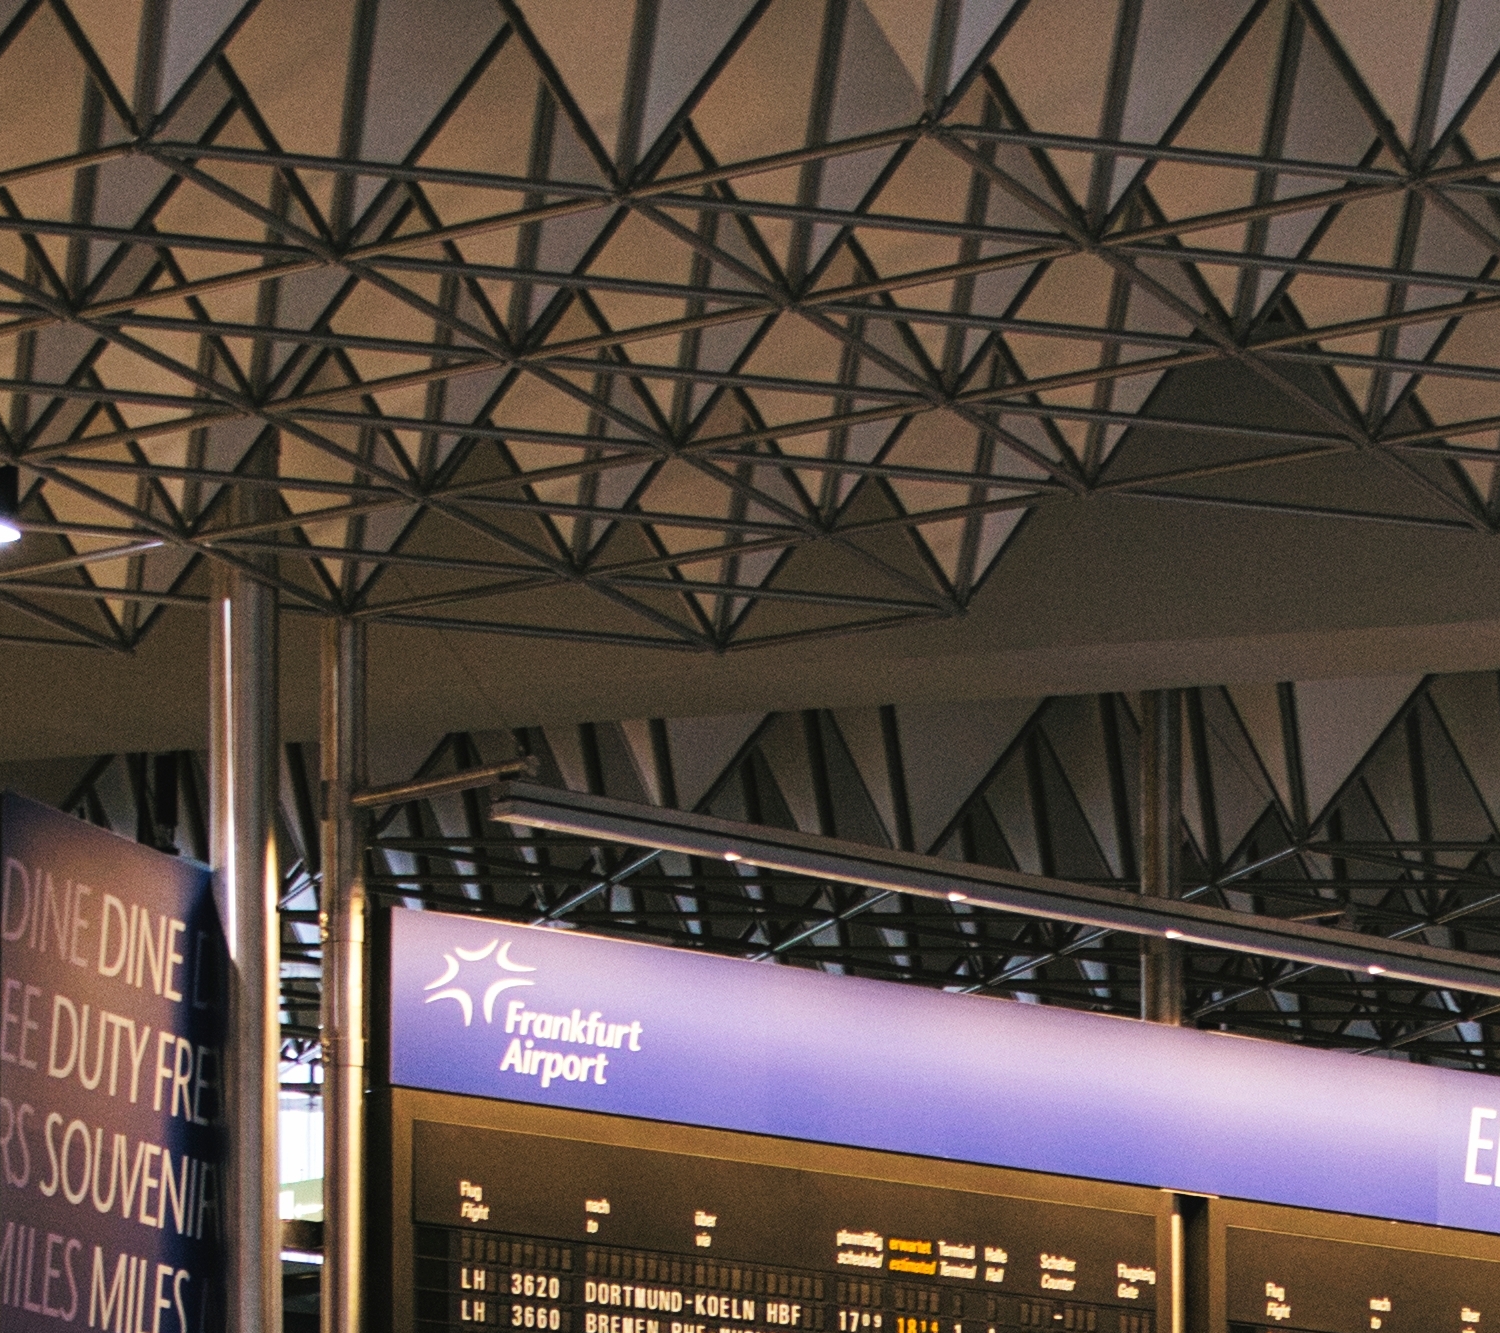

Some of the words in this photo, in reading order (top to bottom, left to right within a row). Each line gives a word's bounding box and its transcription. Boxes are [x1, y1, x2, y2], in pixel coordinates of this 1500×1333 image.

[99, 894, 185, 1002] DINE
[47, 994, 151, 1105] DUTY
[505, 1000, 643, 1052] Frankfurt
[501, 1038, 608, 1087] Airport
[461, 1267, 486, 1290] LH
[511, 1273, 560, 1299] 3620
[585, 1282, 755, 1321] DORTMUND-KOELN
[766, 1302, 801, 1325] HBF
